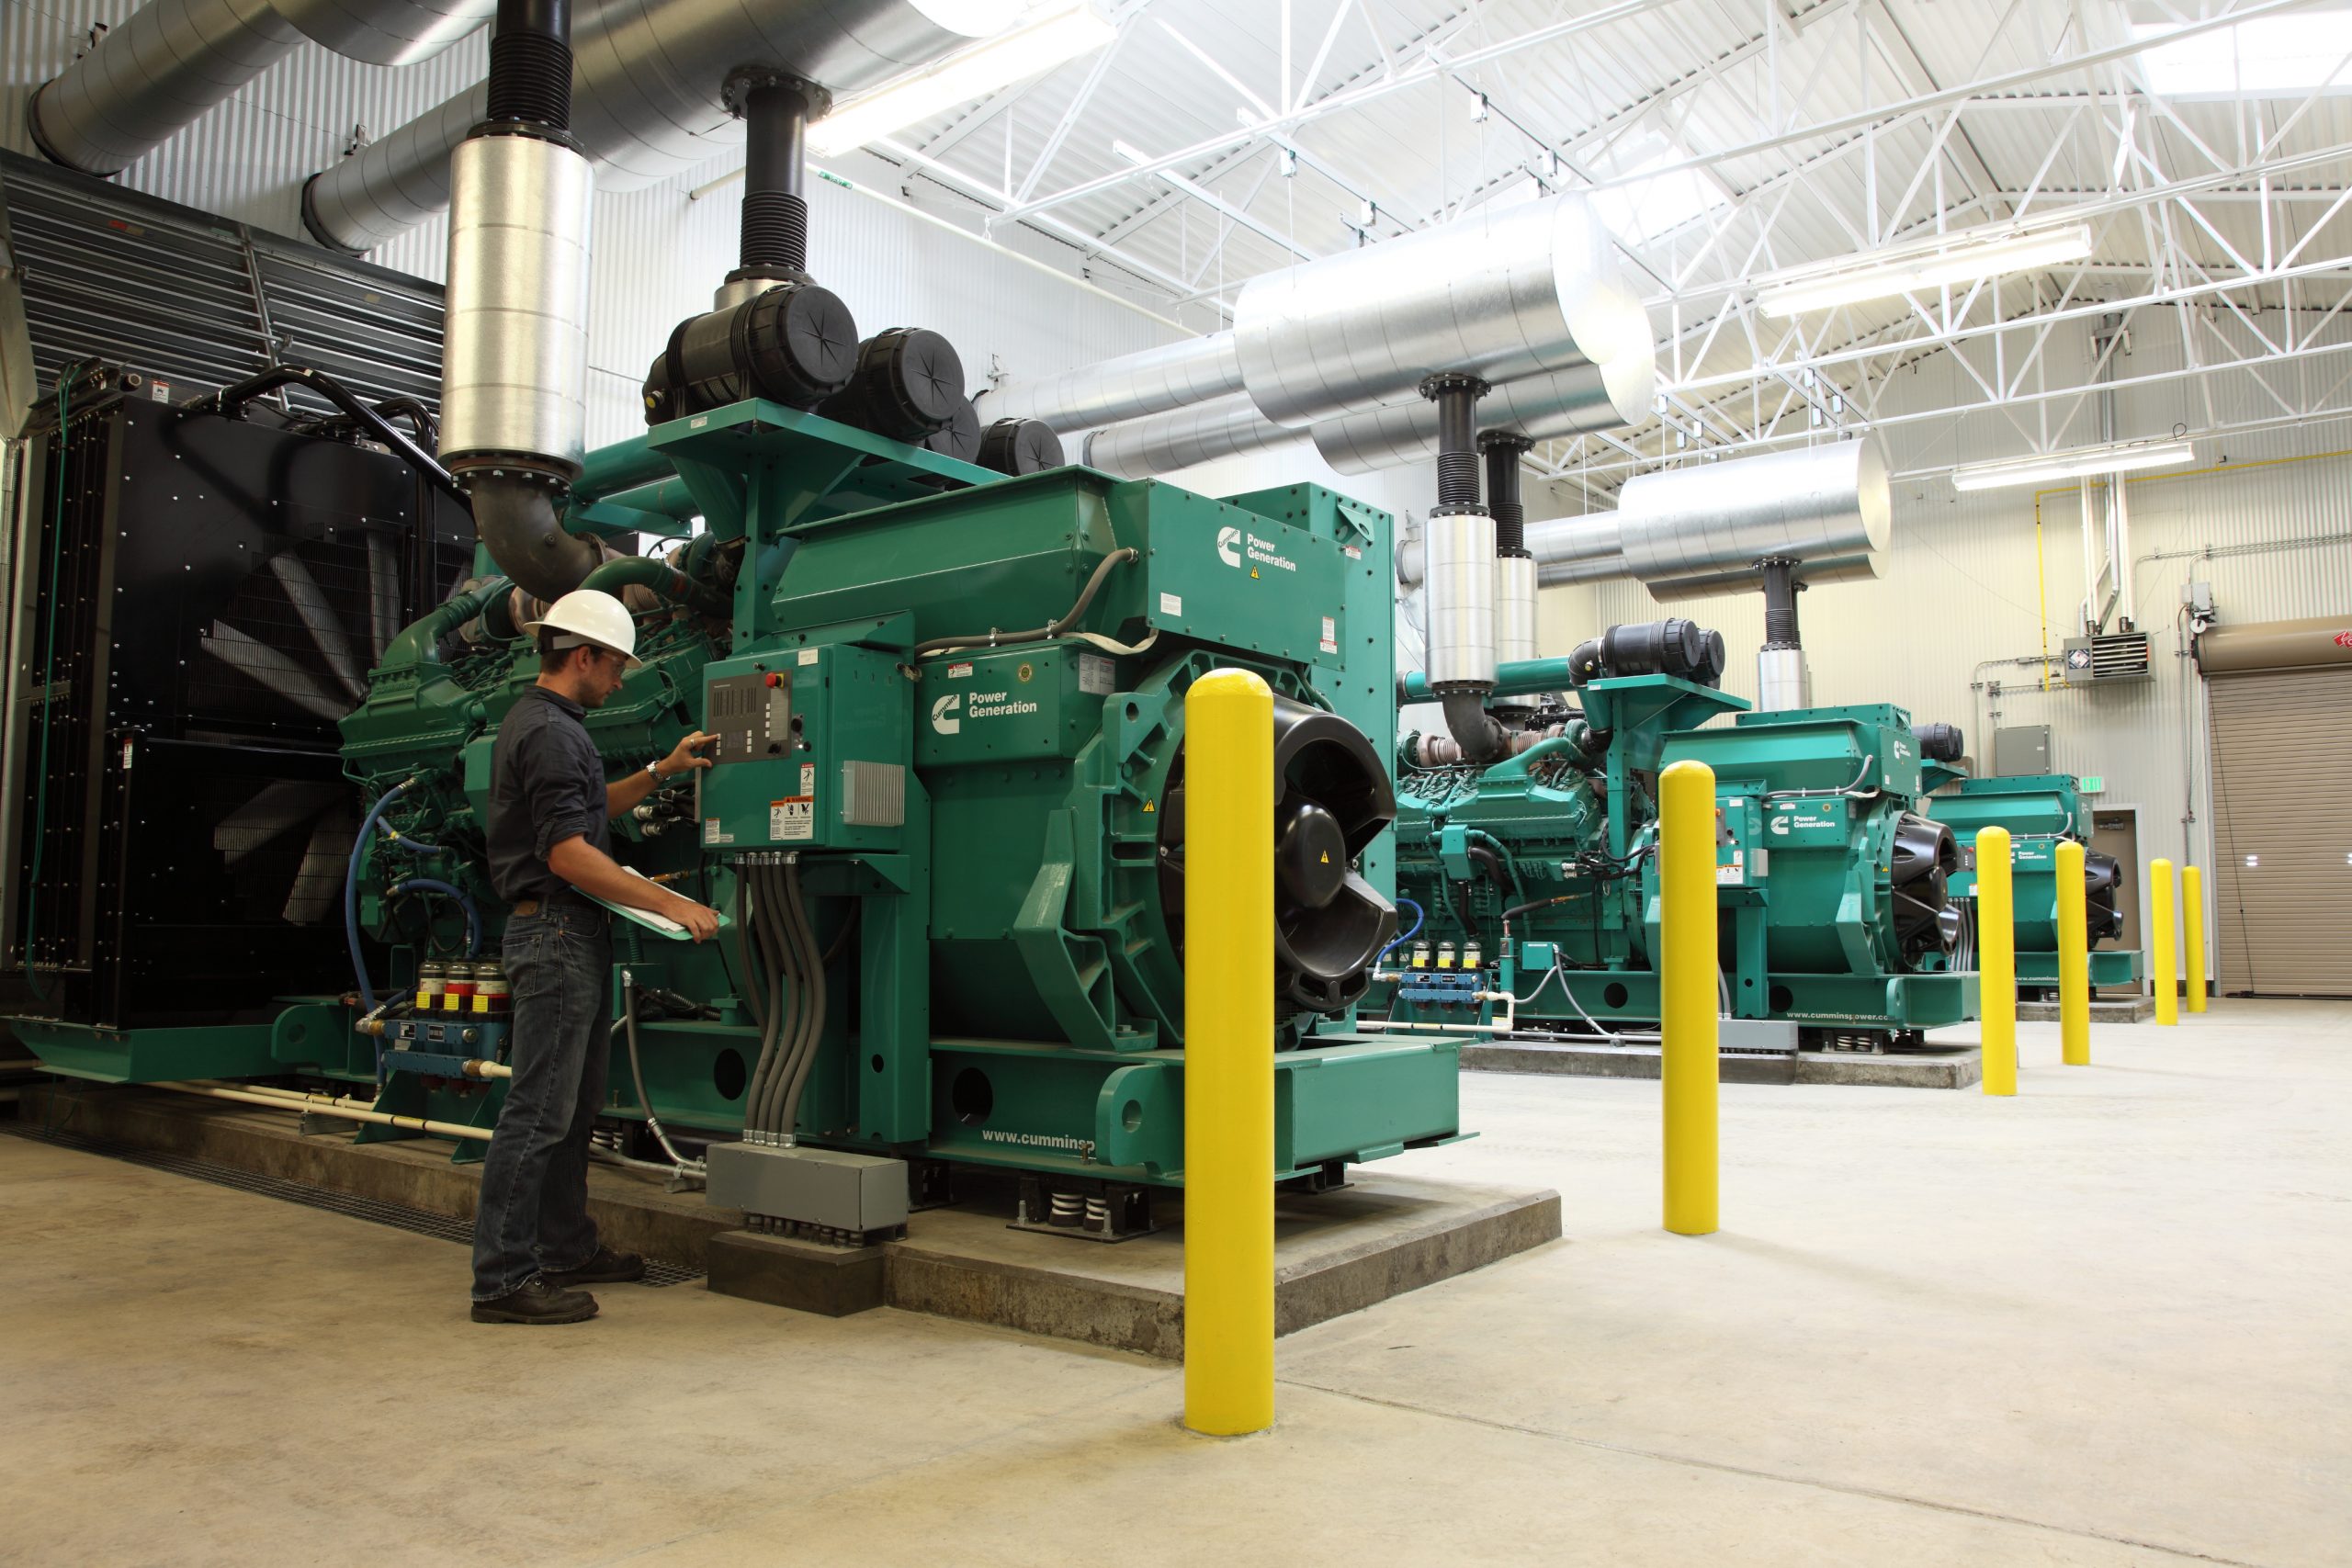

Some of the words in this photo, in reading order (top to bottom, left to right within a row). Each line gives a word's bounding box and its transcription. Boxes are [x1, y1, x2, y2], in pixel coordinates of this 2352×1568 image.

[1218, 529, 1238, 548] Cummins
[1247, 533, 1275, 553] Power
[1247, 546, 1296, 572] Generation
[932, 694, 958, 722] Cummins
[969, 692, 1007, 705] Power
[969, 701, 1037, 718] Generation
